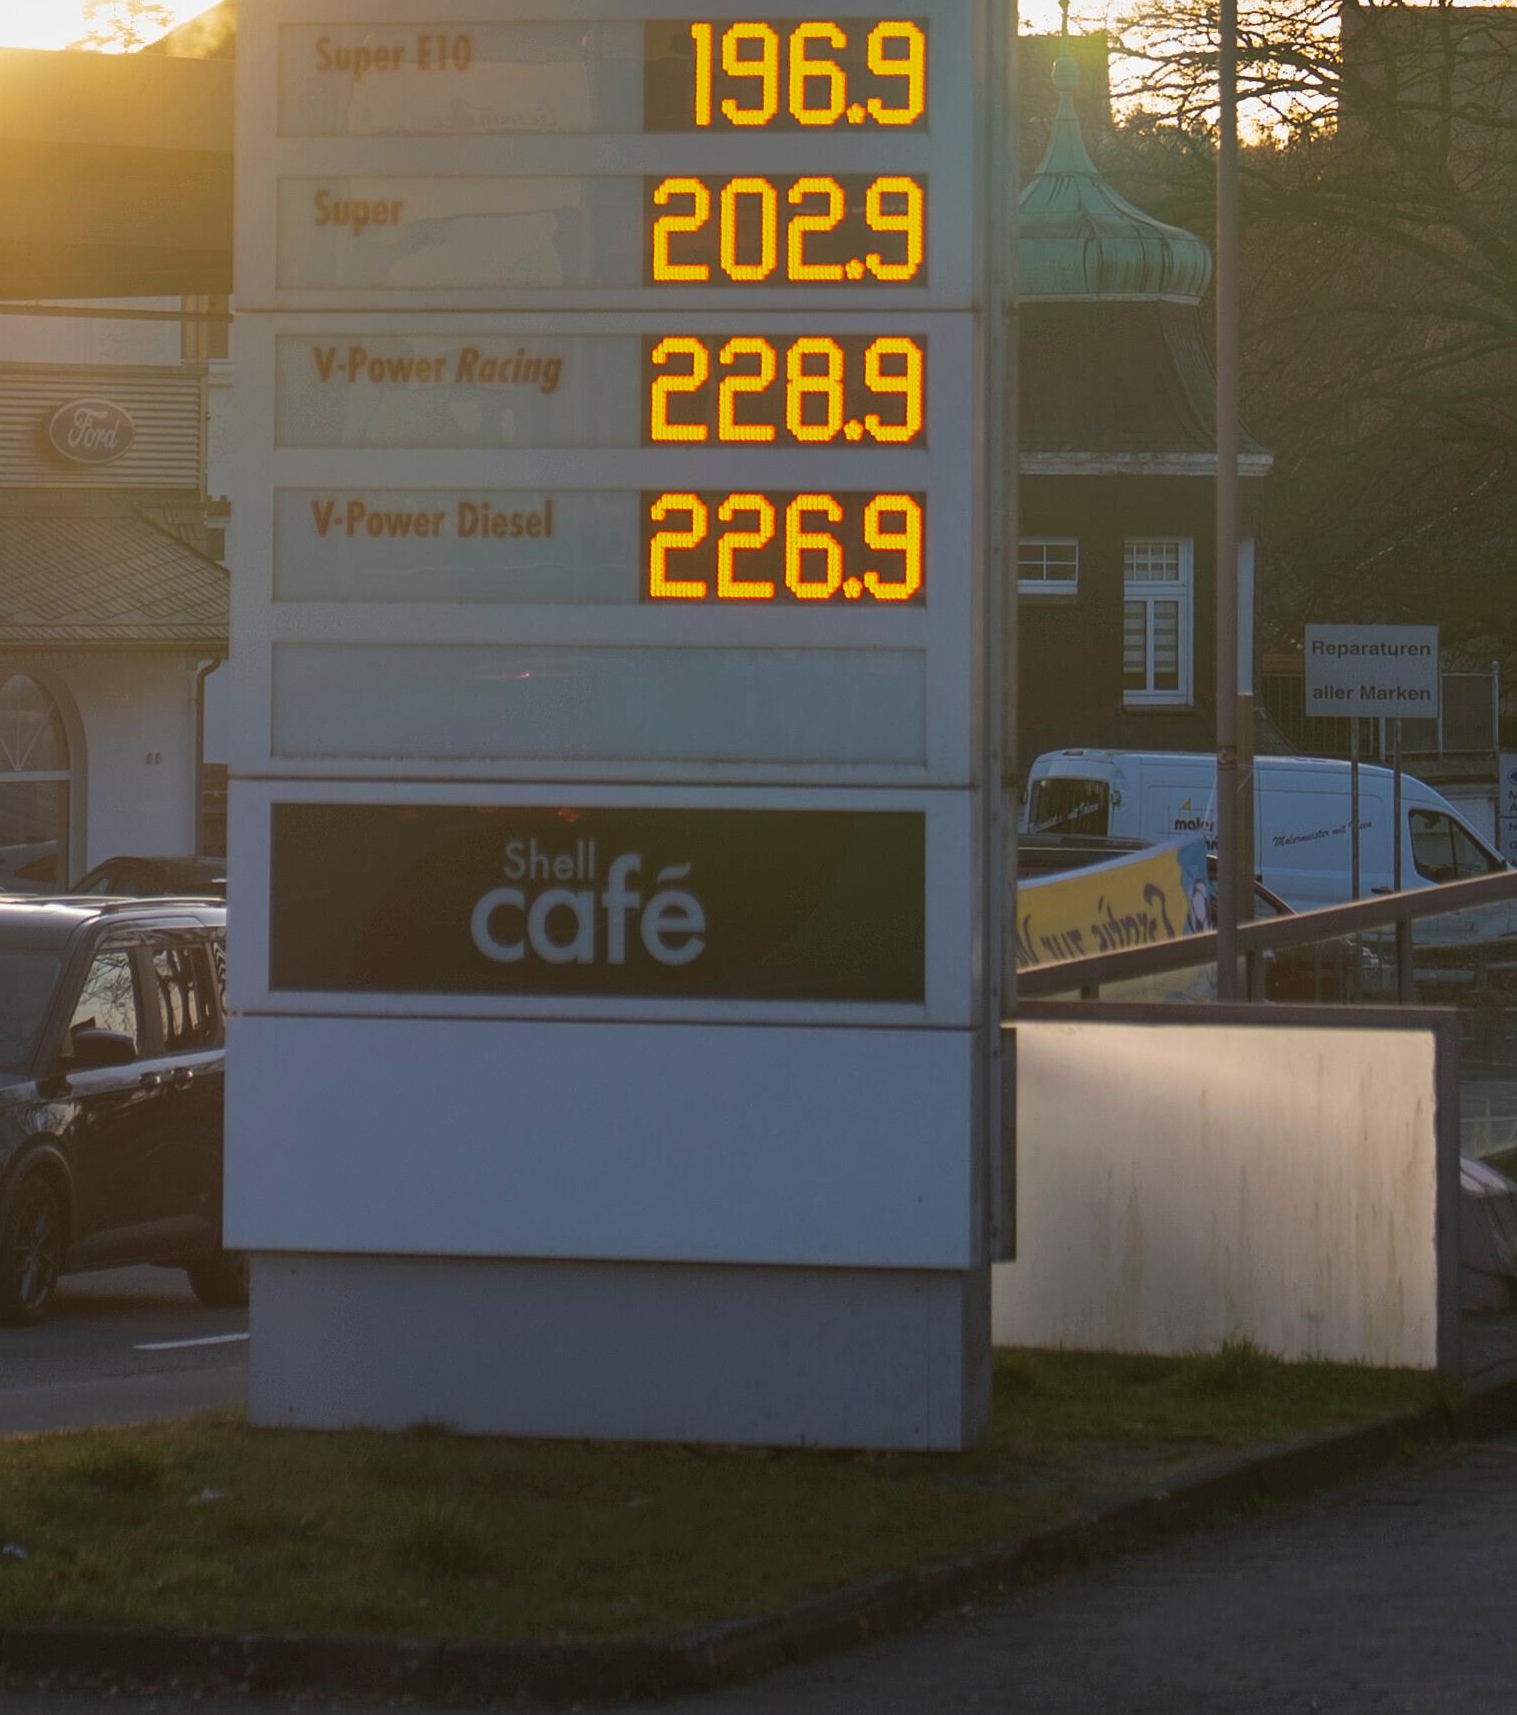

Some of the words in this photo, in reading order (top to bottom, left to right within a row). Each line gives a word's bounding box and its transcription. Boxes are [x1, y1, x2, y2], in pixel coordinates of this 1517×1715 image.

[314, 36, 405, 81] Super
[417, 35, 473, 72] E10
[690, 20, 928, 127] 196.9
[313, 188, 404, 234] Super
[652, 176, 925, 283] 202.9
[68, 408, 120, 449] Ford
[313, 347, 447, 384] V-Power
[455, 347, 564, 393] Racing
[650, 336, 924, 443] 228.9
[312, 500, 446, 538] V-Power
[457, 499, 554, 539] Diesel
[649, 492, 924, 600] 226.9
[1311, 641, 1432, 660] Reparaturen
[1312, 685, 1354, 702] aller
[1359, 685, 1432, 702] Marken
[469, 851, 706, 966] café
[504, 839, 597, 881] Shell
